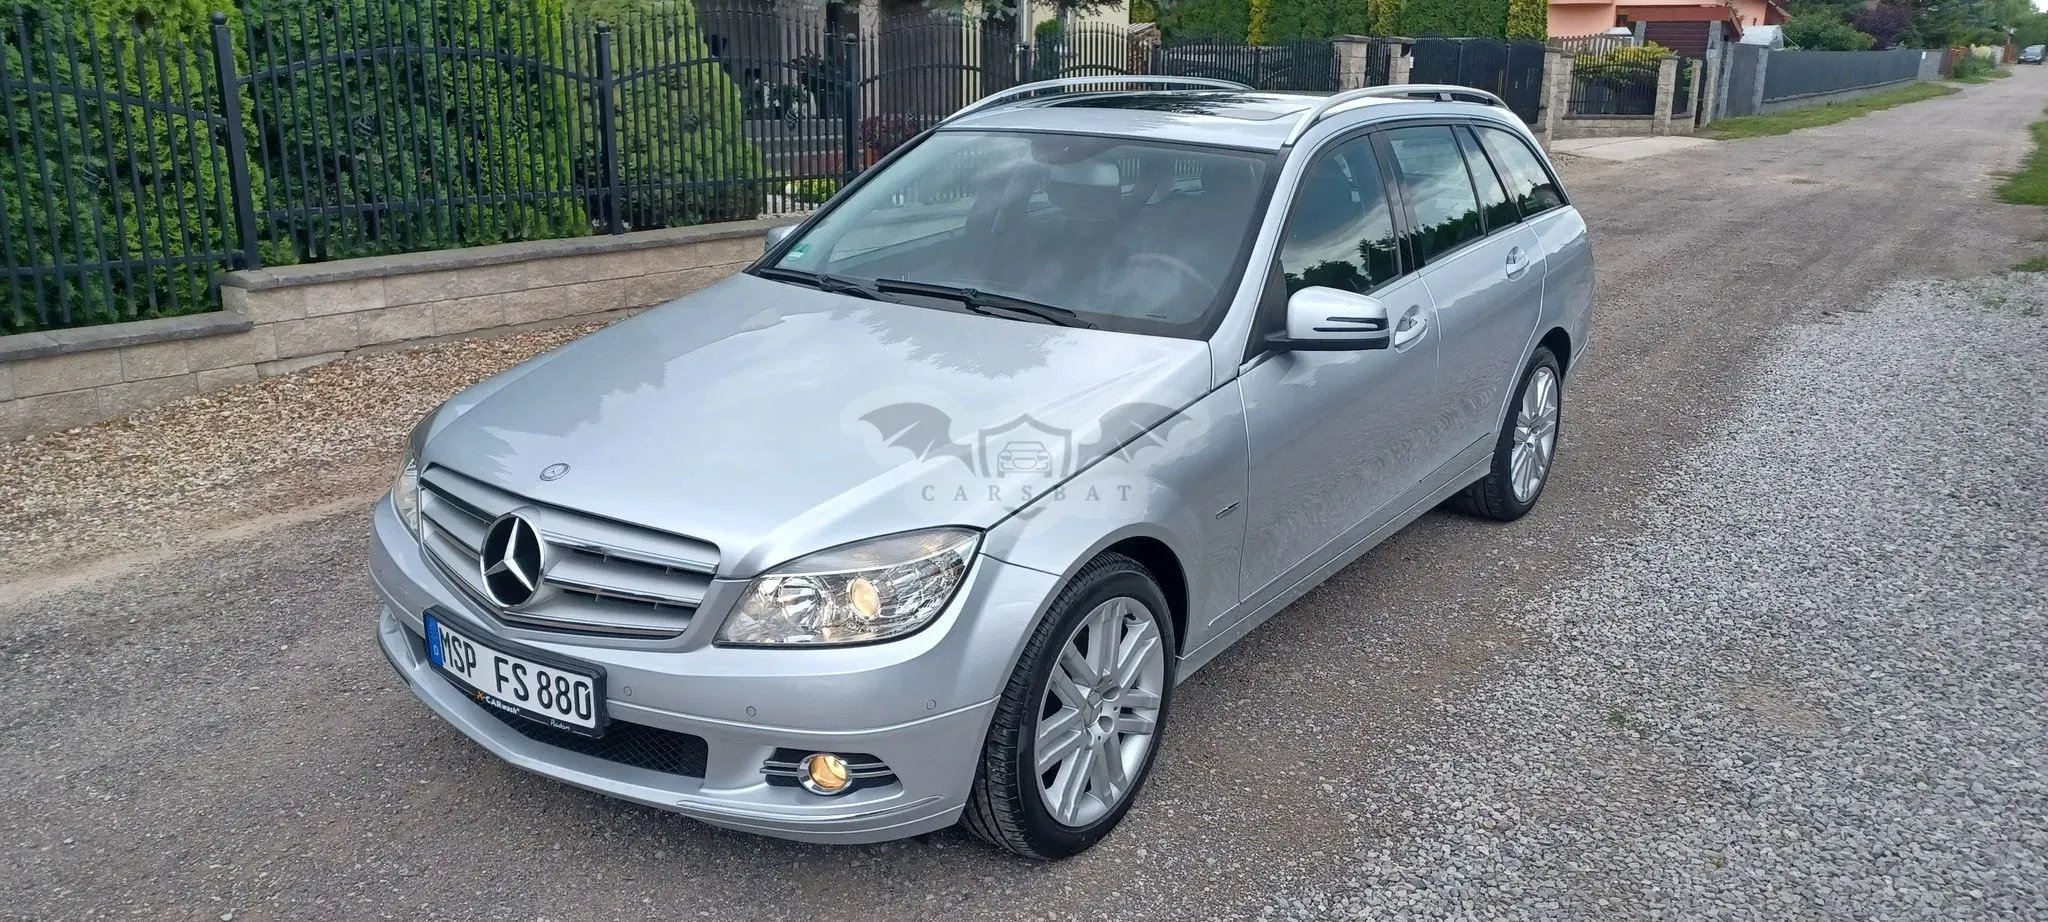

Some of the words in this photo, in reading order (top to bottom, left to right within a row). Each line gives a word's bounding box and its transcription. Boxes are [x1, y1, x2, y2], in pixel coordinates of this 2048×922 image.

[439, 627, 476, 678] MSP
[494, 656, 529, 702] FS
[537, 671, 592, 721] 880
